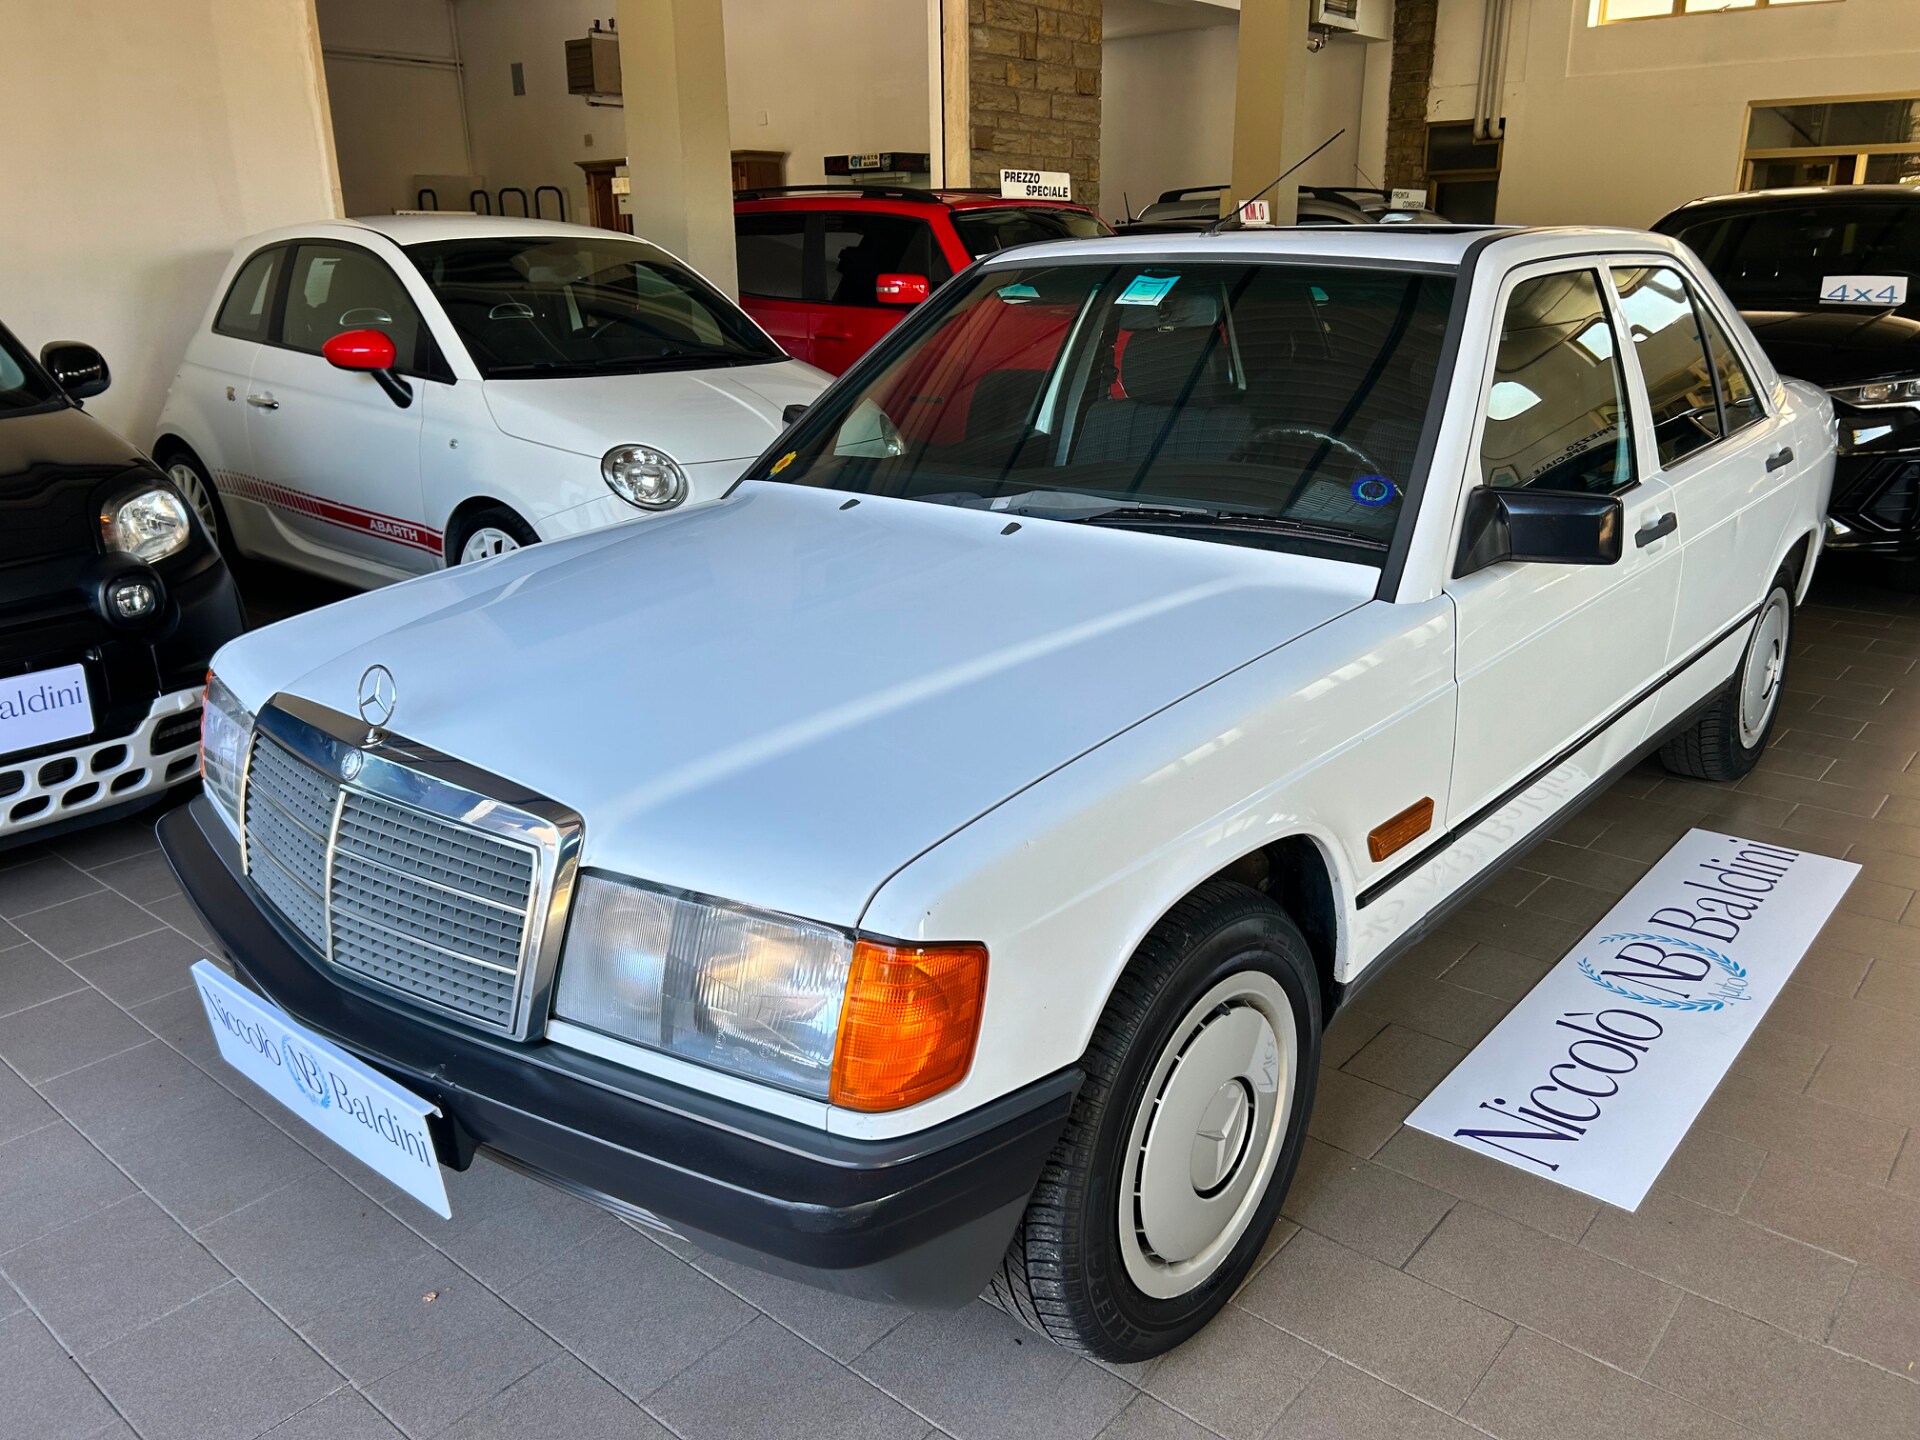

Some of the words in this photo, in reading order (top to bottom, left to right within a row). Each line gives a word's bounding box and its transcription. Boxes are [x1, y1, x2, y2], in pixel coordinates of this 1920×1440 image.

[1004, 171, 1041, 184] PREZZO
[1026, 185, 1069, 198] SPECIALE
[1393, 191, 1410, 199] PRONTA
[1402, 201, 1424, 209] CONSEGNA
[1827, 284, 1898, 304] 4x4
[369, 519, 418, 542] ABARTH
[1647, 839, 1800, 944] Baldini
[1600, 942, 1711, 999] NB
[1707, 976, 1753, 1007] Auto
[202, 985, 282, 1067] Niccolò
[286, 1043, 324, 1096] NB
[328, 1070, 432, 1168] Baldini
[1453, 1008, 1664, 1172] Niccolò
